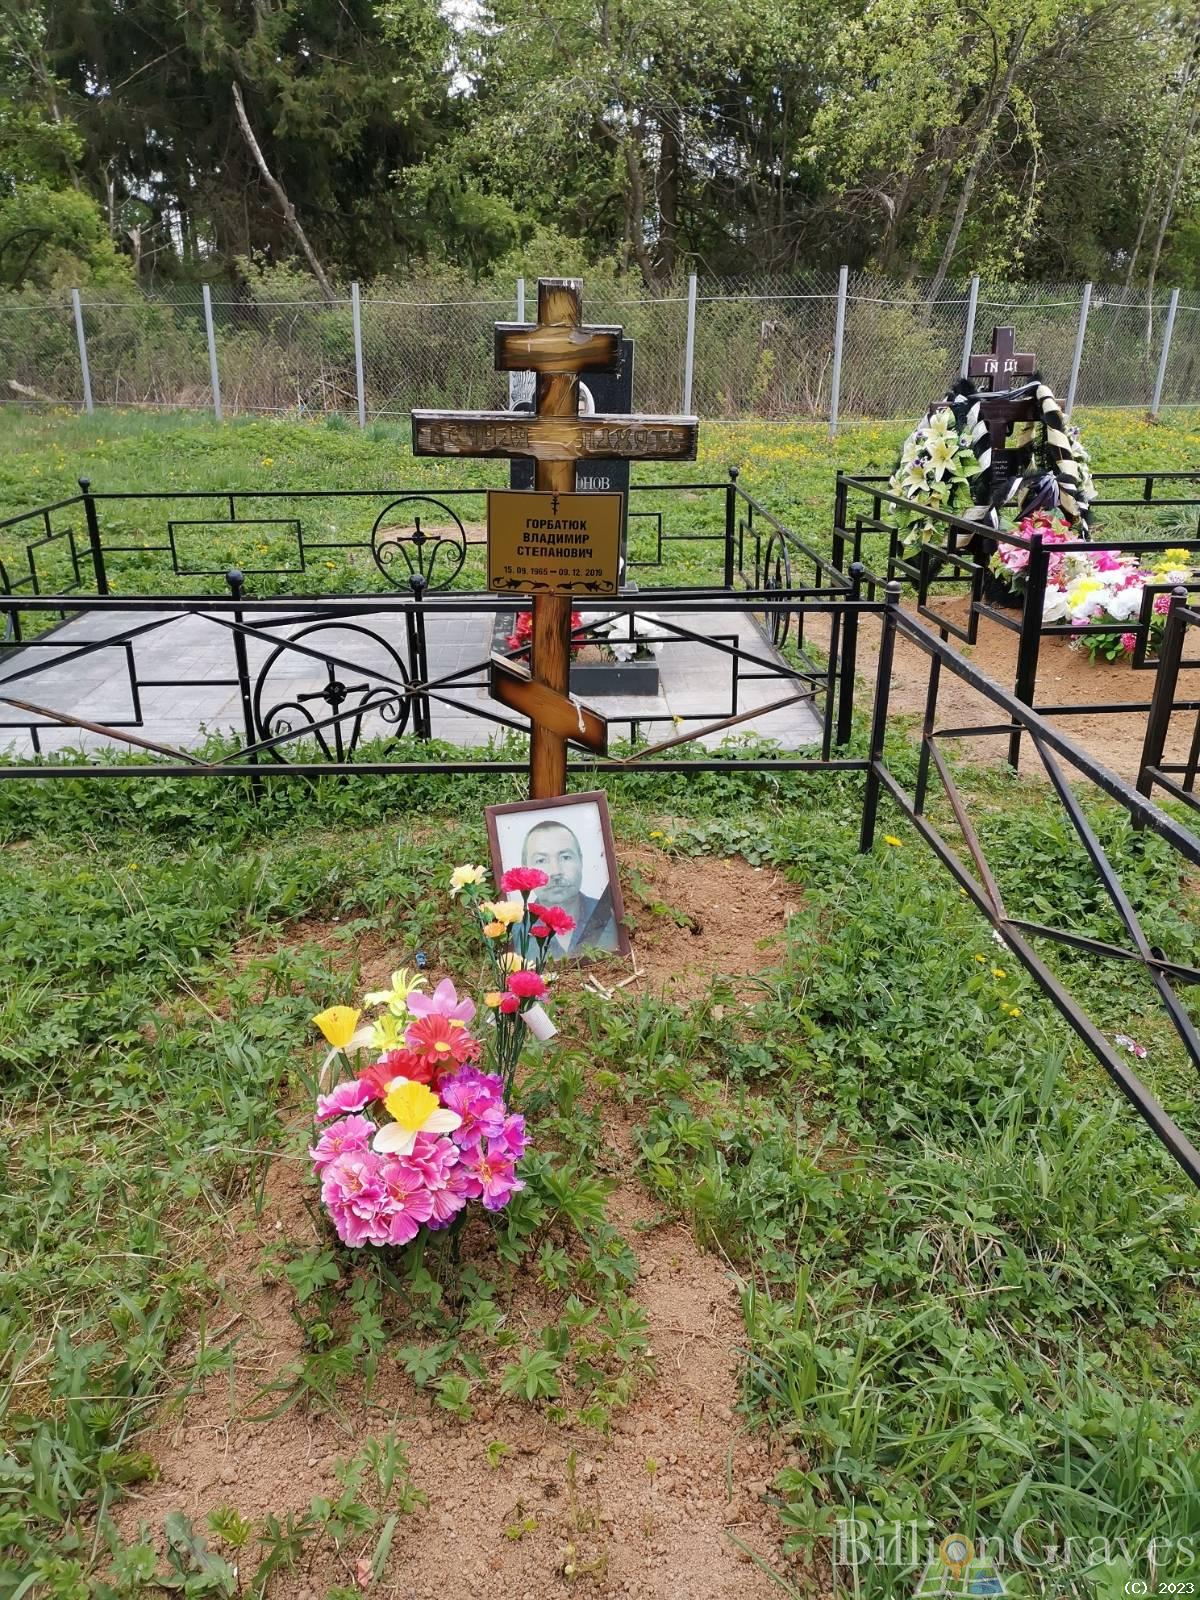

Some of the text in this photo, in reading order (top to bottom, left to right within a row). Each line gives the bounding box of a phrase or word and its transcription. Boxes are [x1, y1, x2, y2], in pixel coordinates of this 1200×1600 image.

[526, 518, 587, 531] ГОРБАТЮК
[523, 533, 590, 545] ВЛАДИМИР
[517, 546, 593, 558] СТЕПАНОВИЧ
